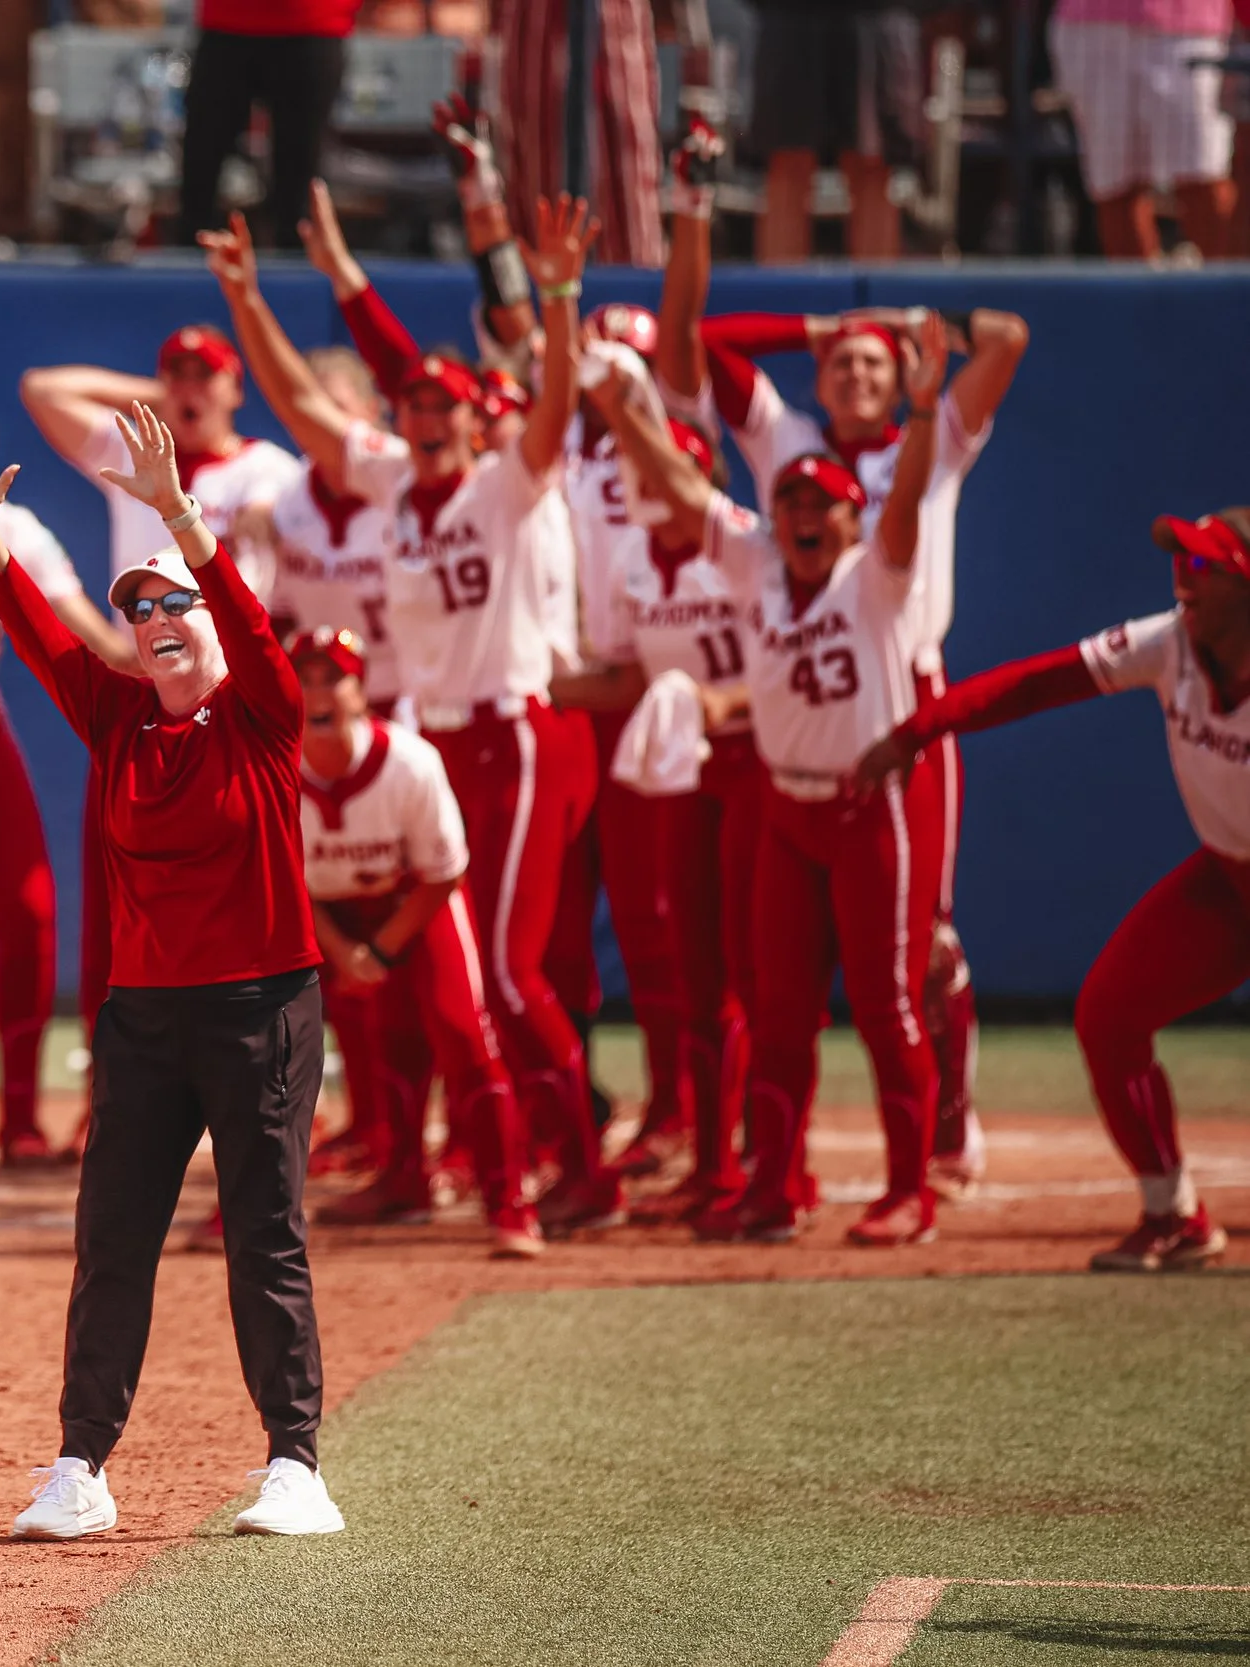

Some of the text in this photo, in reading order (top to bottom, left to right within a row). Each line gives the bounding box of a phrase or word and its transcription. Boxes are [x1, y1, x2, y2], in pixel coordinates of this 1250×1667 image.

[433, 555, 490, 613] 19
[696, 626, 744, 681] 11
[790, 648, 858, 706] 43
